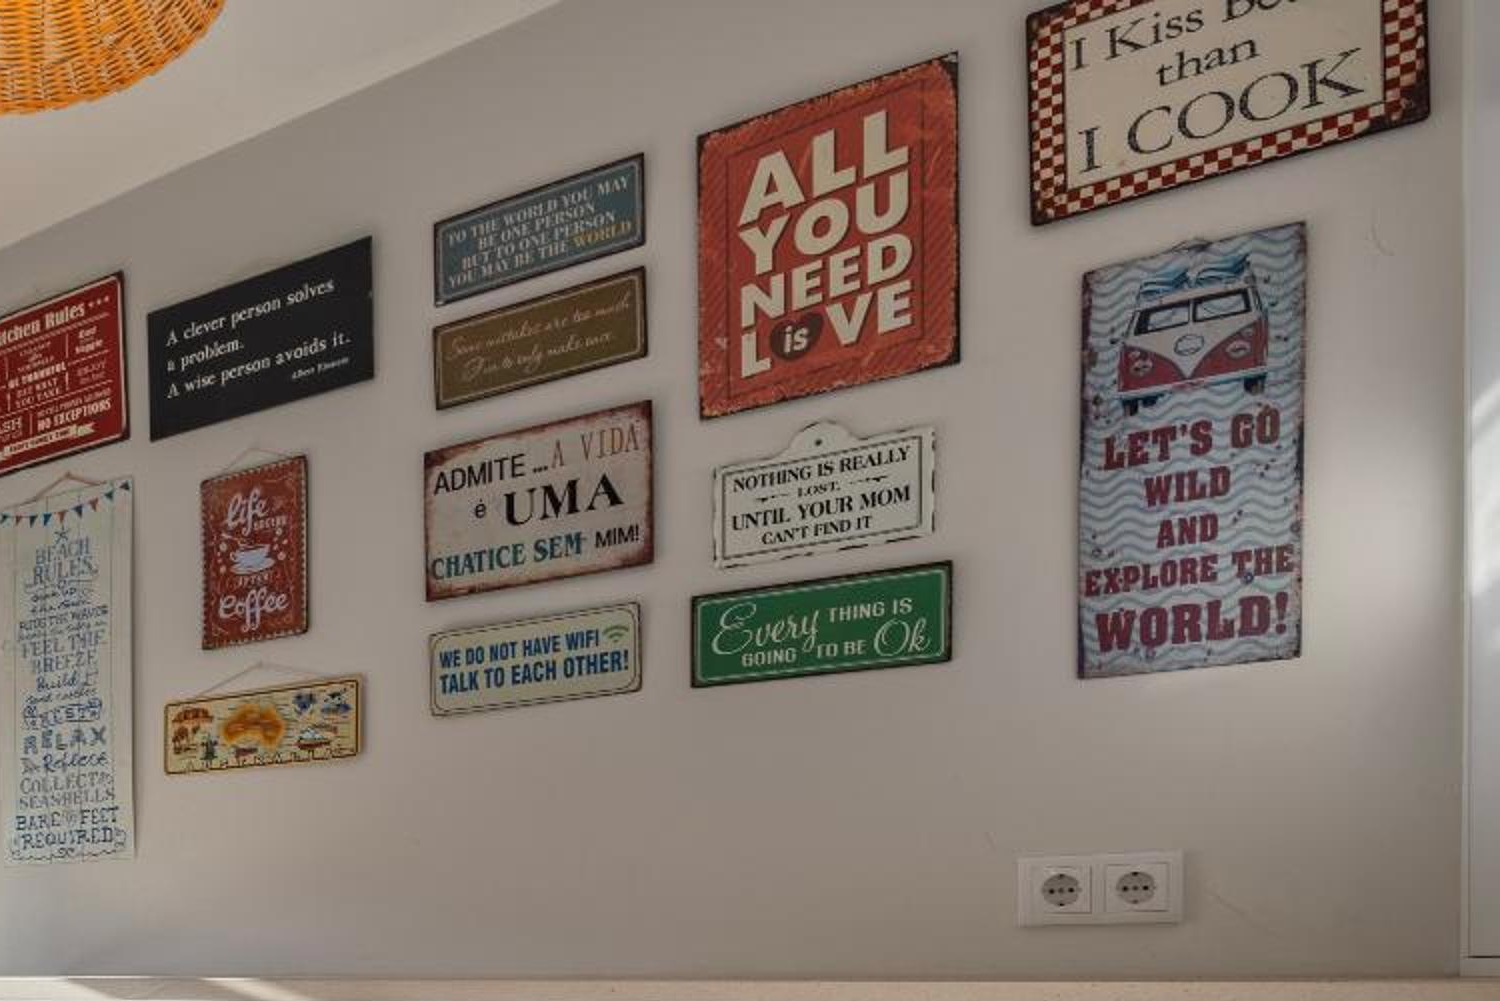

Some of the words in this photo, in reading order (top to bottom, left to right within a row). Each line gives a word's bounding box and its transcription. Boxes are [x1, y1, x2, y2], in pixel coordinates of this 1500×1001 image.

[1069, 37, 1088, 72] I
[1104, 8, 1206, 61] Kiss
[1156, 37, 1261, 87] than
[1078, 126, 1101, 173] I
[1127, 47, 1365, 155] COOK
[739, 109, 909, 227] ALL
[470, 218, 502, 238] THE
[504, 200, 557, 226] WORLD
[561, 188, 594, 207] YOU
[597, 175, 629, 195] MAY
[501, 220, 531, 242] ONE
[535, 202, 595, 232] PERSON
[738, 169, 909, 275] YOU
[519, 231, 550, 251] ONE
[553, 210, 615, 241] PERSON
[449, 270, 479, 288] YOU
[481, 258, 510, 278] MAY
[515, 250, 534, 267] BE
[537, 240, 569, 259] THE
[573, 221, 631, 249] WORLD
[740, 233, 913, 329] NEED
[45, 303, 85, 329] Rules
[166, 329, 178, 346] A
[183, 315, 227, 340] clever
[231, 296, 281, 329] person
[286, 279, 335, 306] solves
[167, 359, 176, 372] a
[180, 339, 244, 372] problem.
[783, 324, 810, 353] is
[167, 383, 180, 399] A
[184, 372, 216, 393] wise
[220, 356, 271, 386] person
[276, 337, 327, 366] avoids
[53, 401, 111, 426] EXCEPTIONS
[581, 422, 640, 461] VIDA
[1103, 419, 1213, 471] LET'S
[1230, 406, 1281, 449] GO
[732, 464, 812, 493] NOTHING
[818, 461, 834, 477] IS
[839, 445, 911, 473] REALLY
[1144, 465, 1231, 508] WILD
[504, 473, 625, 526] UMA
[731, 507, 791, 531] UNTIL
[798, 497, 853, 520] YOUR
[859, 485, 911, 510] MOM
[35, 536, 90, 564] BEACH
[431, 543, 525, 580] CHATICE
[533, 531, 583, 563] SEM
[595, 524, 640, 549] MIM!
[761, 525, 809, 545] CAN'T
[813, 519, 851, 537] FIND
[855, 515, 872, 531] IT
[1156, 513, 1219, 549] AND
[33, 556, 98, 585] RULES
[1084, 554, 1219, 598] EXPLORE
[1232, 543, 1295, 578] THE
[711, 602, 820, 655] Every
[827, 601, 886, 623] THING
[892, 597, 913, 616] IS
[740, 647, 797, 668] GOING
[816, 643, 837, 659] TO
[844, 640, 867, 656] BE
[873, 617, 931, 657] Ok
[1095, 591, 1289, 653] WORLD!
[439, 649, 461, 669] WE
[465, 646, 485, 665] DO
[489, 641, 518, 663] NOT
[522, 635, 561, 657] HAVE
[565, 628, 600, 650] WIFI
[439, 671, 480, 695] TALK
[483, 667, 505, 689] TO
[511, 660, 557, 686] EACH
[563, 649, 629, 679] OTHER!
[24, 726, 106, 754] RELAX
[20, 788, 115, 809] SEASHELLS
[21, 772, 98, 794] COLLECT
[16, 812, 60, 830] BARE
[81, 806, 118, 824] FEET
[21, 827, 112, 849] REQUIRED
